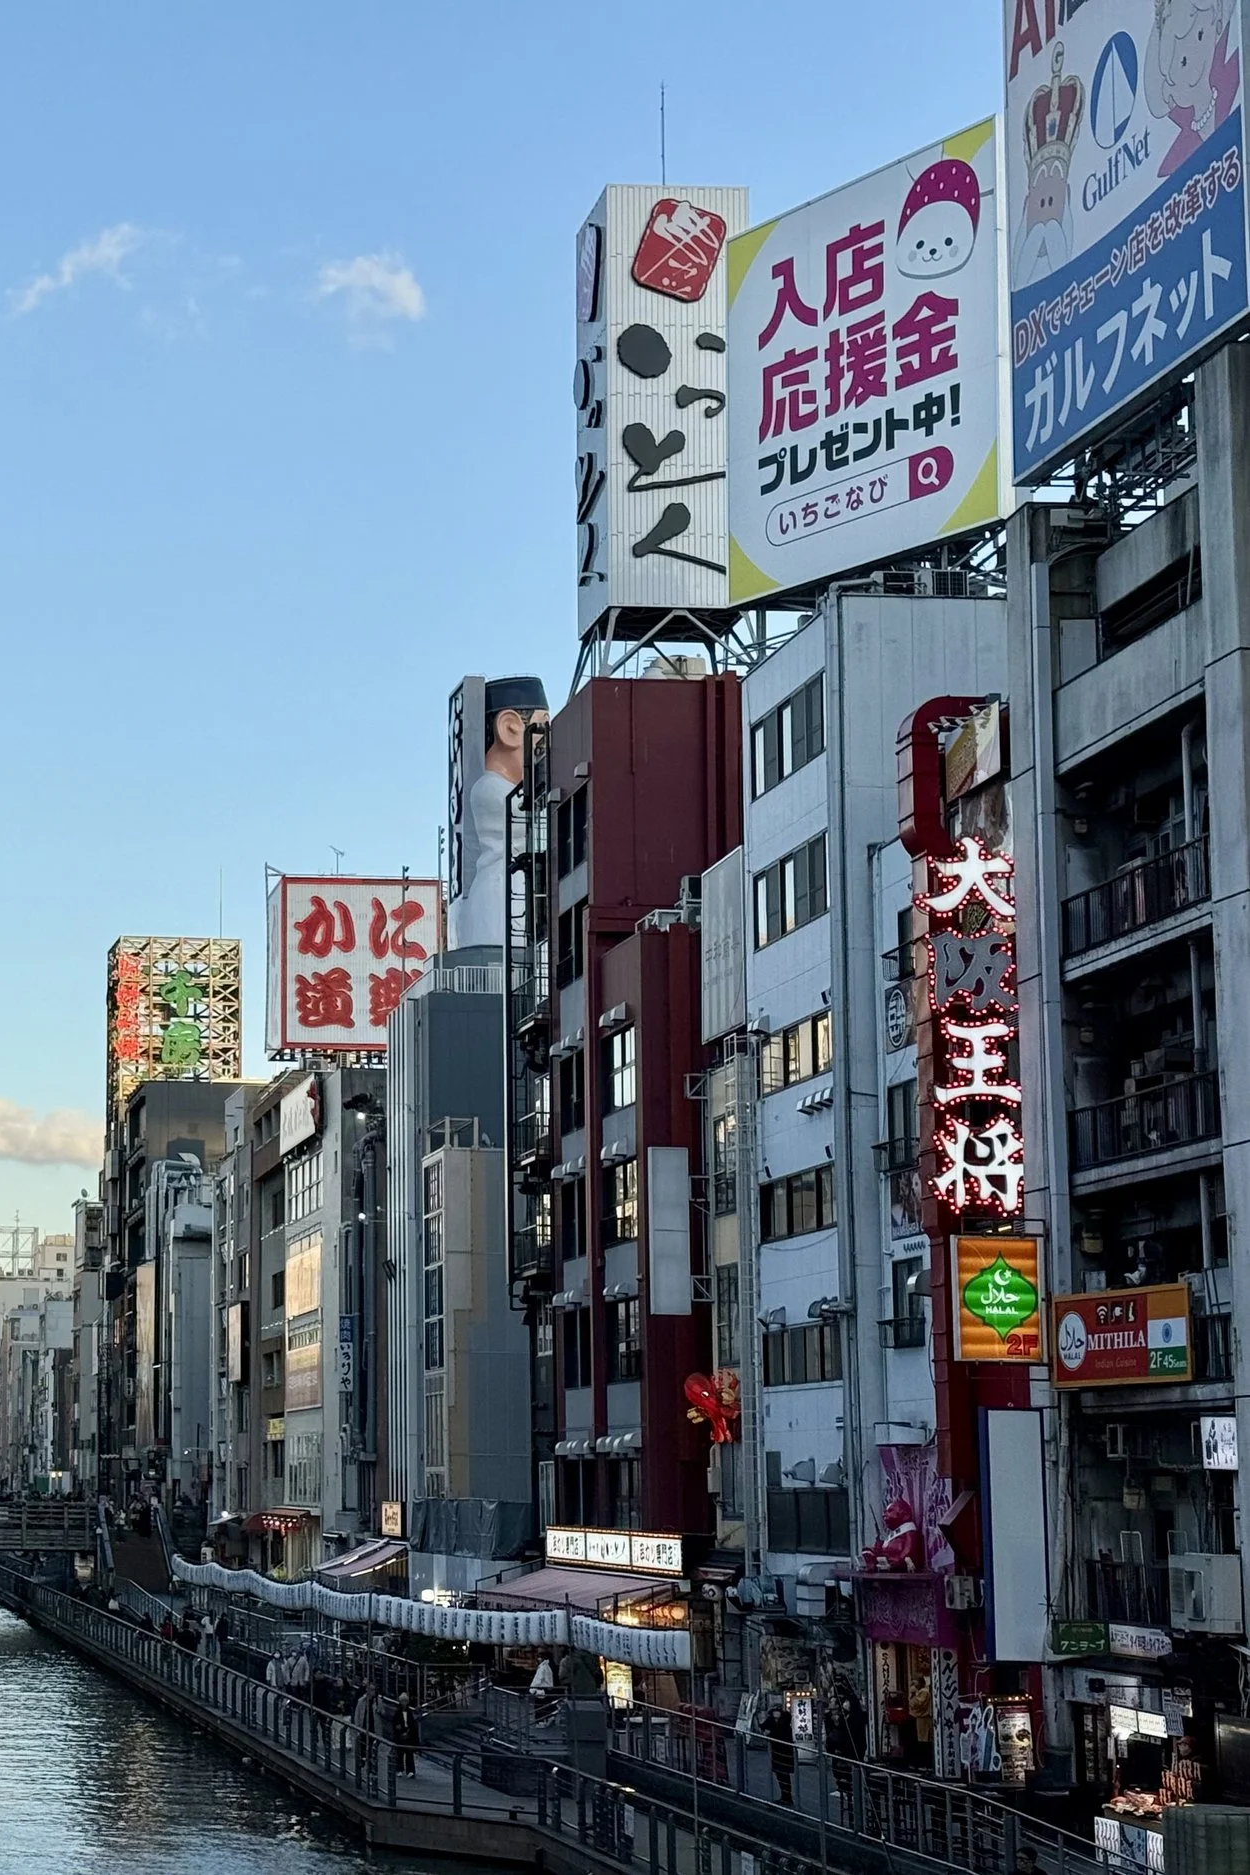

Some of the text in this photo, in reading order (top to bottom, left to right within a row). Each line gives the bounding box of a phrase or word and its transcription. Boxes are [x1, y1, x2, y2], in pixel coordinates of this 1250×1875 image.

[1013, 146, 1240, 369] DXでチェーン店を改革する
[758, 219, 885, 350] 入店
[1024, 228, 1233, 453] ガルフネット
[758, 290, 959, 445] 応援金
[778, 473, 890, 536] いちごなび
[294, 895, 428, 960] かに
[917, 836, 1024, 1214] 大阪王将
[981, 1283, 1020, 1305] حلال
[985, 1306, 1019, 1315] HALAL
[340, 1318, 351, 1341] 焼肉
[1006, 1333, 1039, 1356] 2F
[1087, 1330, 1146, 1351] MITHILA
[340, 1343, 352, 1390] いろりや
[1062, 1350, 1083, 1361] HALAL
[1150, 1351, 1163, 1369] 2F
